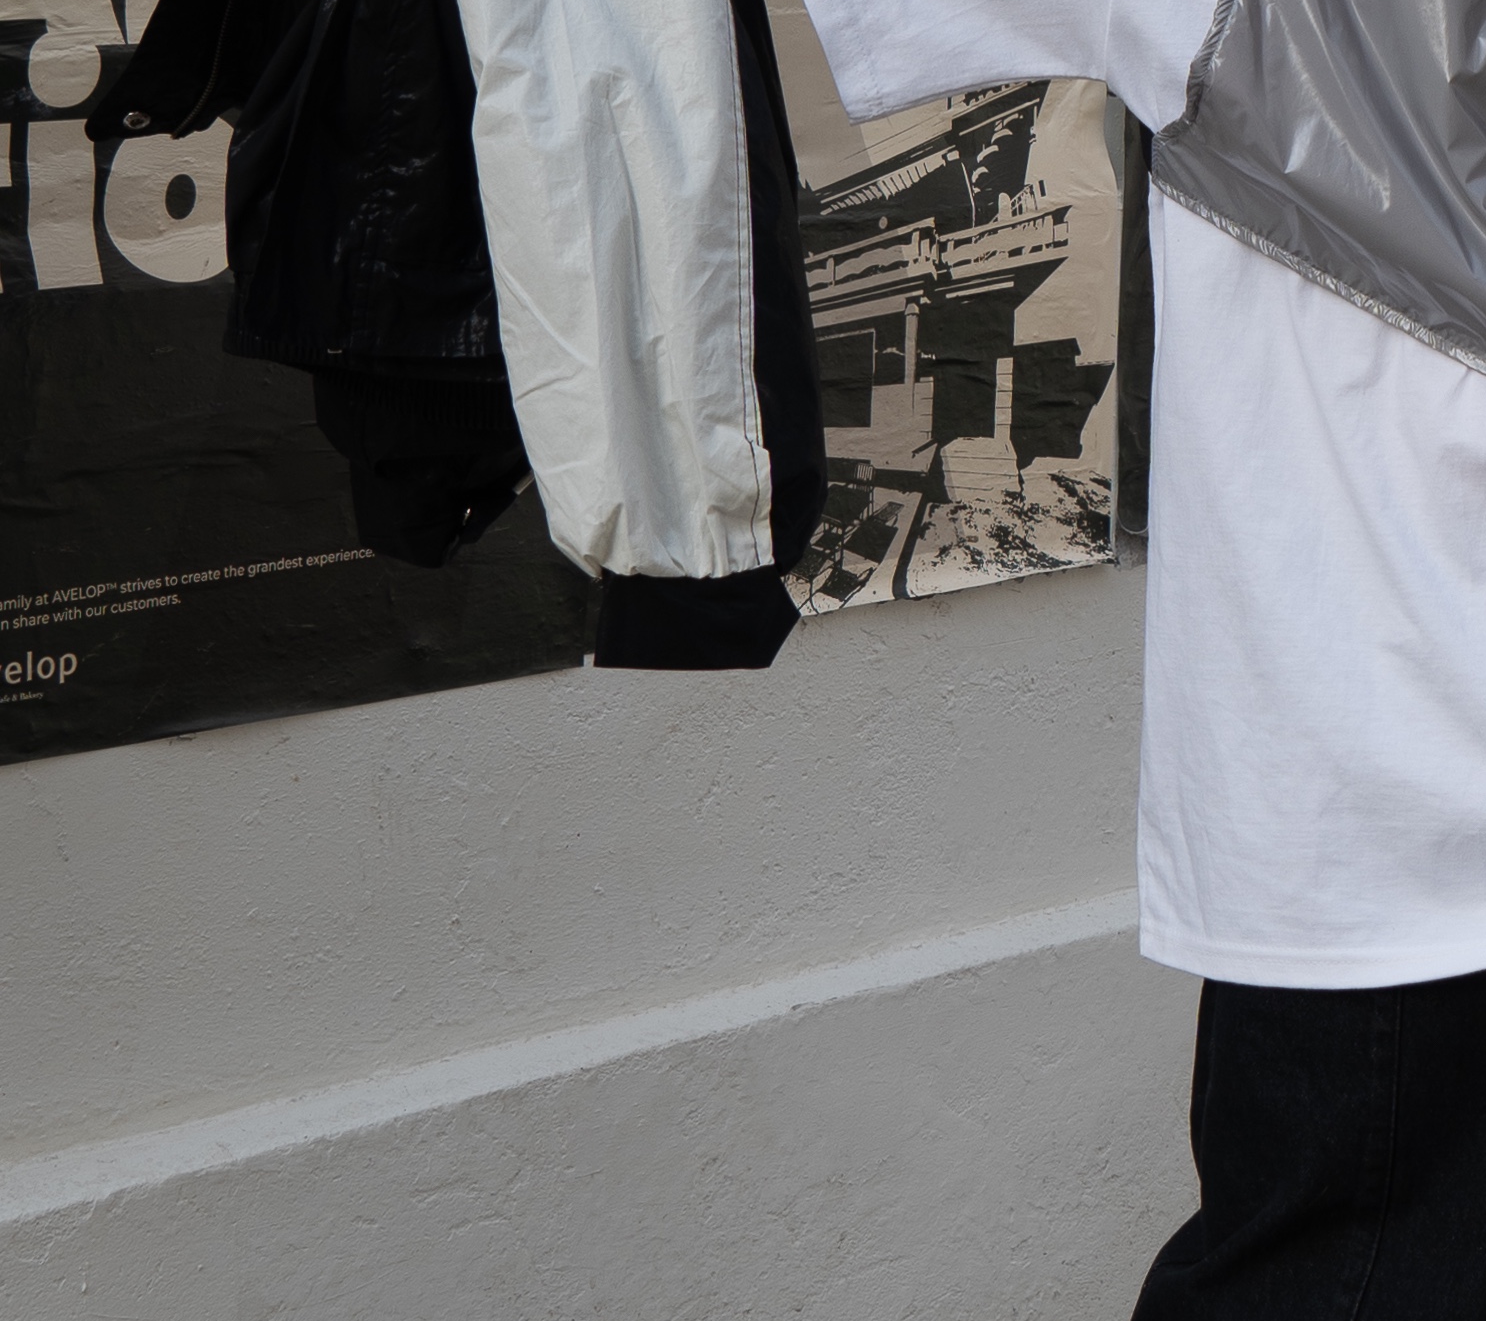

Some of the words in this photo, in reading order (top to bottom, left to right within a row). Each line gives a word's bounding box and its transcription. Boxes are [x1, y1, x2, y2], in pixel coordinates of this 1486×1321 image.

[35, 593, 49, 607] at
[120, 577, 162, 594] strives
[165, 575, 178, 587] to
[181, 568, 221, 585] create
[224, 565, 245, 578] the
[247, 556, 303, 577] grandest
[306, 548, 375, 568] experience.
[12, 614, 50, 630] share
[53, 607, 82, 623] with
[85, 603, 108, 617] our
[110, 593, 181, 615] customers.
[0, 651, 78, 684] elop
